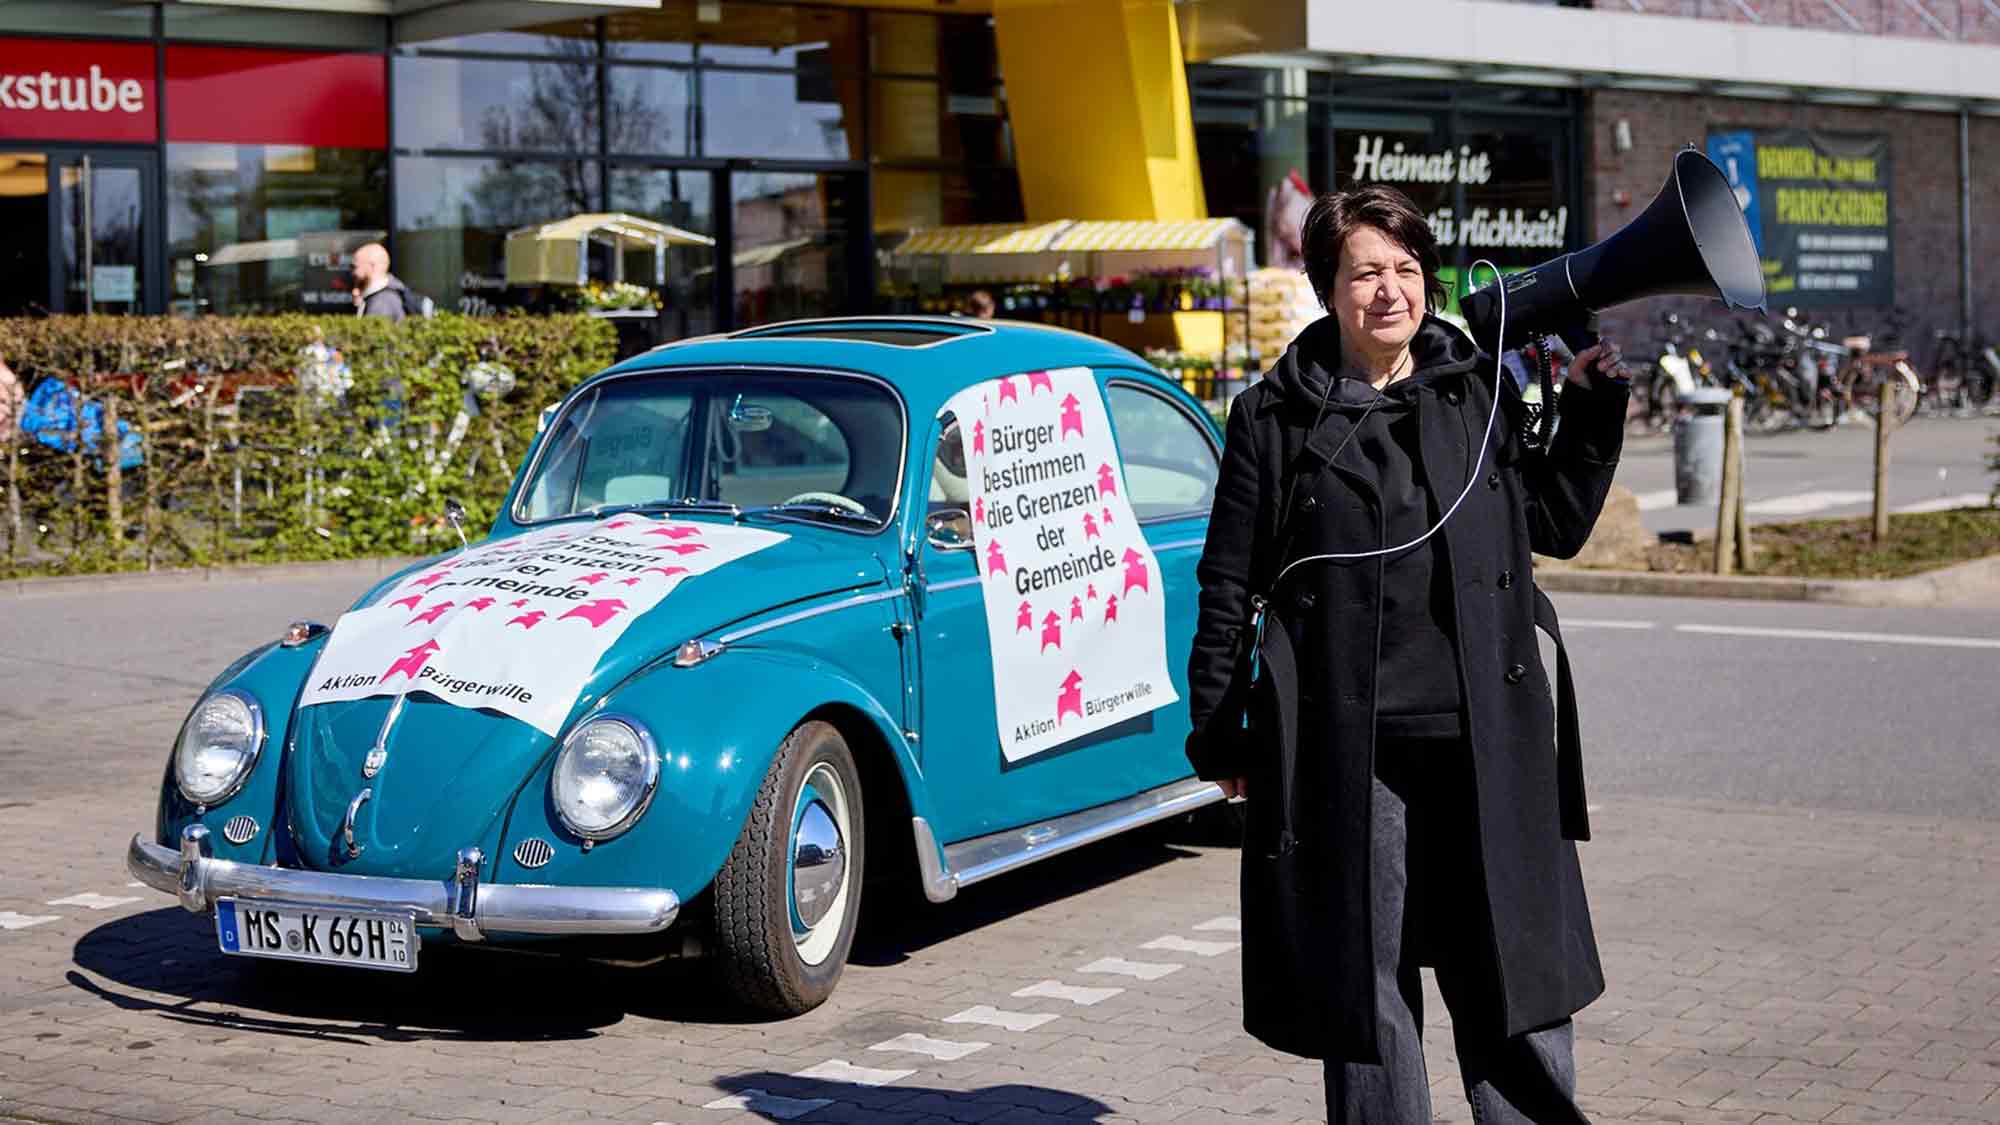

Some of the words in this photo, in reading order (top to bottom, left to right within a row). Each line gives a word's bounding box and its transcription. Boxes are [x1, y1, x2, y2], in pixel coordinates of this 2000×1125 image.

[1352, 135, 1455, 182] Heimat
[1458, 145, 1491, 183] ist
[992, 424, 1055, 454] Bürger
[983, 452, 1085, 493] bestimmen
[987, 500, 1014, 529] die
[1016, 484, 1097, 520] Grenzen
[1036, 524, 1065, 551] der
[1015, 545, 1116, 595] Gemeinde
[319, 673, 377, 692] Aktion
[419, 665, 533, 704] Bürgerwille
[1015, 718, 1056, 743] Aktion
[1086, 682, 1153, 715] Bürgerwille
[226, 930, 234, 942] D
[245, 909, 282, 949] MS
[302, 913, 321, 952] K
[328, 916, 387, 960] 66H
